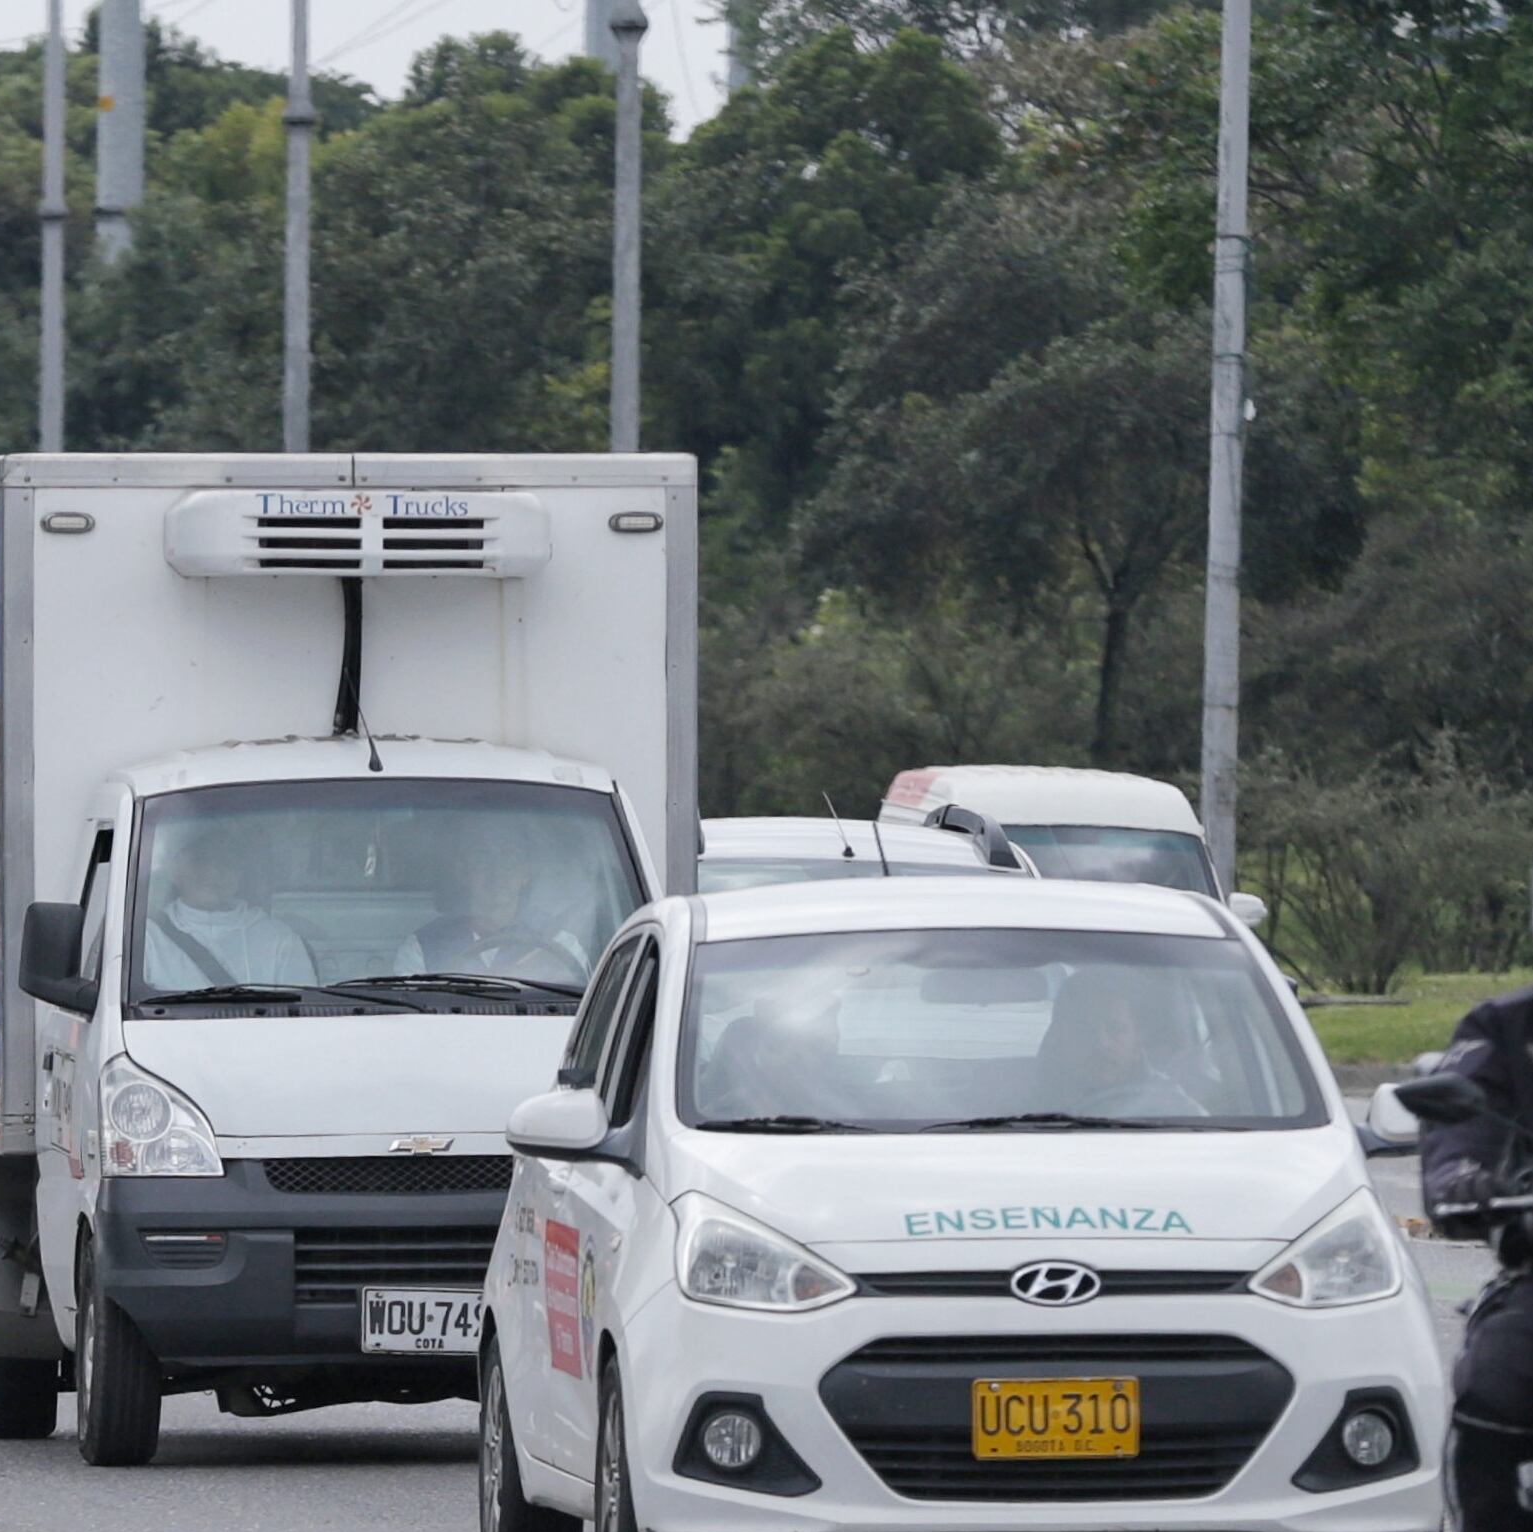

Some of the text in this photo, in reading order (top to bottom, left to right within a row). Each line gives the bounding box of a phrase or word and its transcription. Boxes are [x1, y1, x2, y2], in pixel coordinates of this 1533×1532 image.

[255, 493, 469, 517] Therm Trucks
[903, 1205, 1194, 1237] ENSEÑANZA
[414, 1337, 445, 1350] COTA
